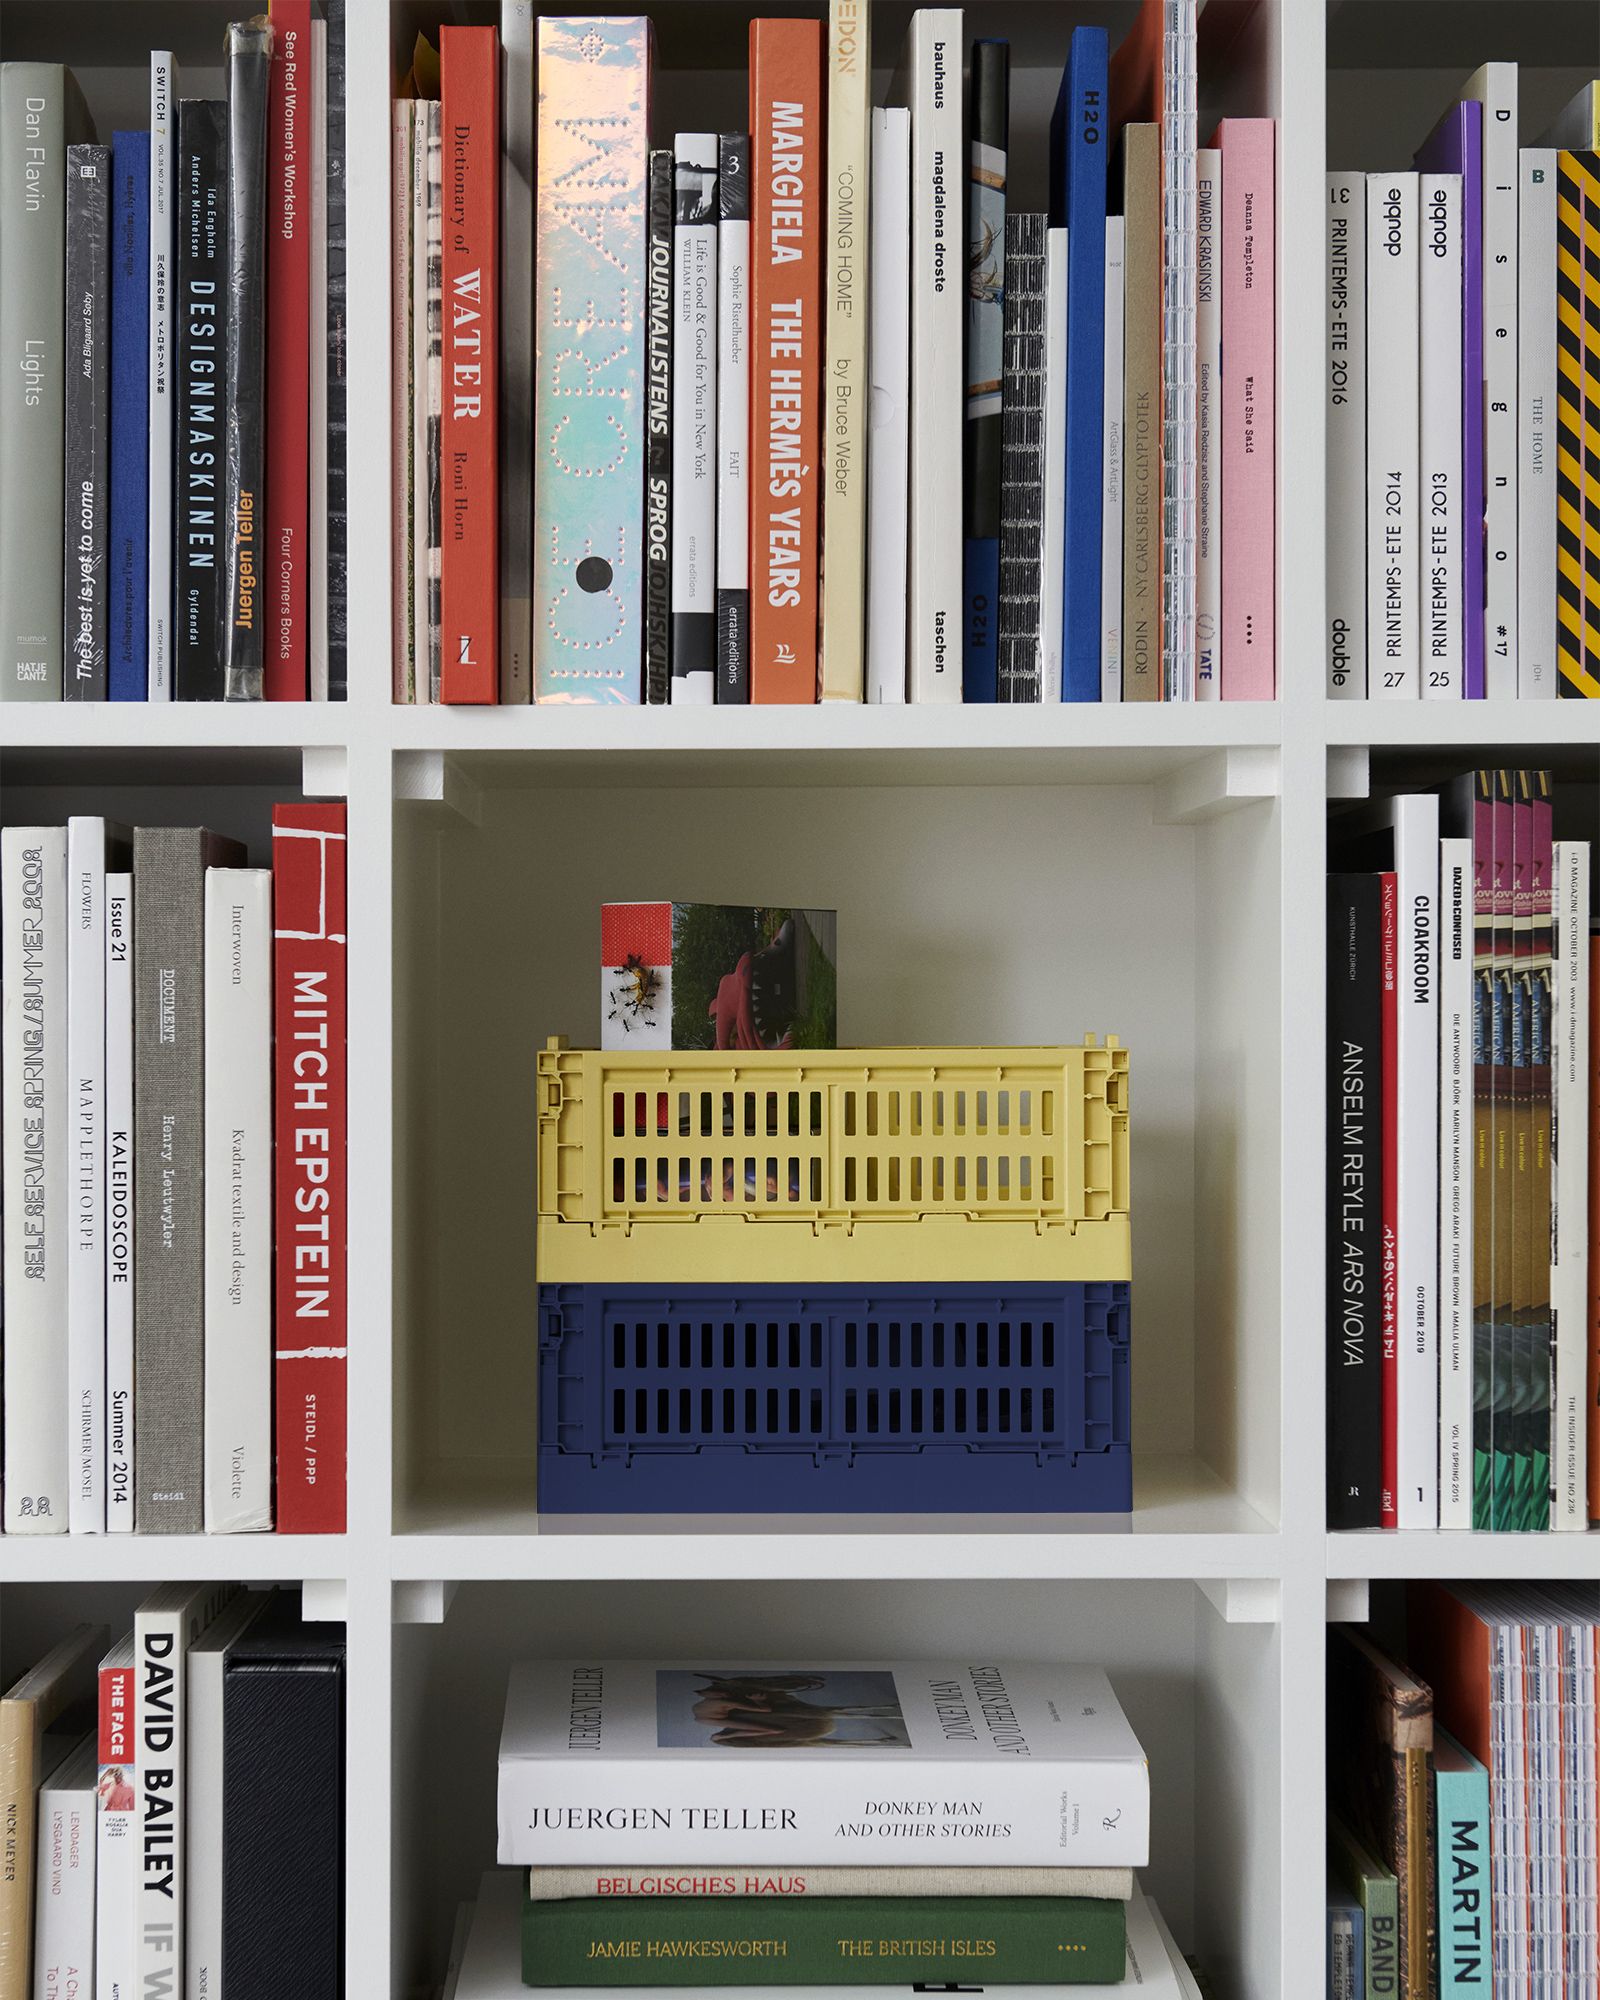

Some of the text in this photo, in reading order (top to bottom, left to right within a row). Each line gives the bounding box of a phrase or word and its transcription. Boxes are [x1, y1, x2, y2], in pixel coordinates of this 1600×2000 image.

[156, 66, 166, 121] SWITCH
[1083, 91, 1100, 145] H2O
[26, 98, 46, 212] Dan Flavin
[281, 31, 297, 240] See Red Women's Workshop
[415, 158, 423, 192] december
[450, 126, 470, 254] Dictionary of
[728, 156, 740, 175] 3
[932, 42, 946, 294] bauhaus magdalena droste
[1532, 169, 1545, 183] B
[191, 199, 200, 259] Michelsen
[1199, 180, 1212, 232] EDWARD
[1383, 188, 1401, 257] double
[1429, 189, 1447, 258] double
[206, 210, 216, 259] Engholm
[683, 239, 691, 285] WILLIAM
[730, 264, 743, 299] Sophie
[1244, 236, 1254, 289] Templeton
[452, 268, 482, 420] WATER
[652, 235, 670, 435] JOURNALISTENS
[694, 239, 708, 479] Life Good Good New York
[768, 102, 810, 608] MARGIELA THE HERMÈS YEARS
[21, 341, 46, 406] Lights
[83, 359, 92, 378] Ada
[1200, 363, 1210, 391] Edited
[1245, 376, 1254, 403] What
[1331, 361, 1350, 405] 2016
[189, 281, 215, 568] DESIGNMASKINEN
[834, 359, 851, 497] by Bruce Weber
[730, 451, 740, 478] FAIT
[1533, 433, 1544, 474] HOME
[453, 452, 469, 541] Roni Horn
[650, 477, 668, 561] SPROG
[1386, 471, 1402, 516] 2014
[1432, 472, 1448, 516] 2013
[235, 489, 257, 629] Juergen Teller
[1136, 391, 1149, 675] RODIN GLYPTOTEK
[77, 481, 97, 681] The best is yet to come
[688, 563, 697, 598] editions
[190, 589, 199, 646] Gyldendal
[280, 561, 292, 660] Corners Books
[729, 607, 738, 639] errata
[971, 594, 989, 648] H2O
[17, 663, 47, 672] HATJE
[935, 610, 945, 674] taschen
[1199, 649, 1212, 680] TATE
[1332, 618, 1350, 687] double
[17, 672, 47, 681] CANTZ
[1383, 672, 1405, 688] 27
[1429, 671, 1450, 688] 25
[82, 871, 92, 930] FLOWERS
[1453, 866, 1462, 898] DAZED
[112, 897, 126, 962] Issue 21
[231, 905, 244, 985] Interwoven
[1414, 895, 1430, 1004] CLOAKROOM
[1570, 916, 1578, 959] OCTOBER
[160, 969, 175, 1043] DOCUMENT
[22, 846, 45, 1282] SELF SERVICE SPRING/SUMMER 2008
[79, 1079, 94, 1251] MAPPLETHORPE
[293, 972, 330, 1318] MITCH EPSTEIN
[1452, 1146, 1460, 1181] MANSON
[112, 1131, 128, 1283] KALEIDOSCOPE
[161, 1169, 175, 1248] Leutwyler
[228, 1129, 246, 1306] Kvadrat textile and design
[1342, 1041, 1365, 1366] ANSELM REYLE ARS NOVA
[1417, 1286, 1425, 1327] OCTOBER
[1568, 1396, 1576, 1416] THE
[81, 1389, 92, 1501] SCHIRMER/MOSEL
[113, 1390, 128, 1504] Summer 2014
[305, 1394, 316, 1485] STEIDL PPP
[232, 1446, 245, 1499] Violette
[1416, 1487, 1424, 1502] 1
[1452, 1453, 1460, 1482] SPRING
[968, 1665, 1010, 1703] STORIES
[110, 1674, 125, 1757] THE FACE
[935, 1701, 978, 1741] DONKEY
[144, 1633, 174, 1952] DAVID BAILEY IF
[528, 1807, 799, 1831] JUERGEN TELLER
[864, 1801, 984, 1816] DONKEY MAN
[53, 1811, 63, 1868] LYSGAARD
[69, 1811, 80, 1869] LENDAGER
[834, 1823, 1013, 1838] AND OTHER STORIES
[1059, 1818, 1068, 1848] Editorial
[1072, 1809, 1080, 1836] Volume
[4, 1840, 16, 1881] MEYER
[596, 1876, 807, 1895] BELGISCHES HAUS
[1451, 1820, 1482, 1984] MARTIN
[47, 1967, 59, 1982] To
[586, 1940, 789, 1958] JAMIE HAWKESWORTH
[837, 1939, 998, 1957] THE BRITISH ISLES
[1371, 1916, 1395, 1994] BAND
